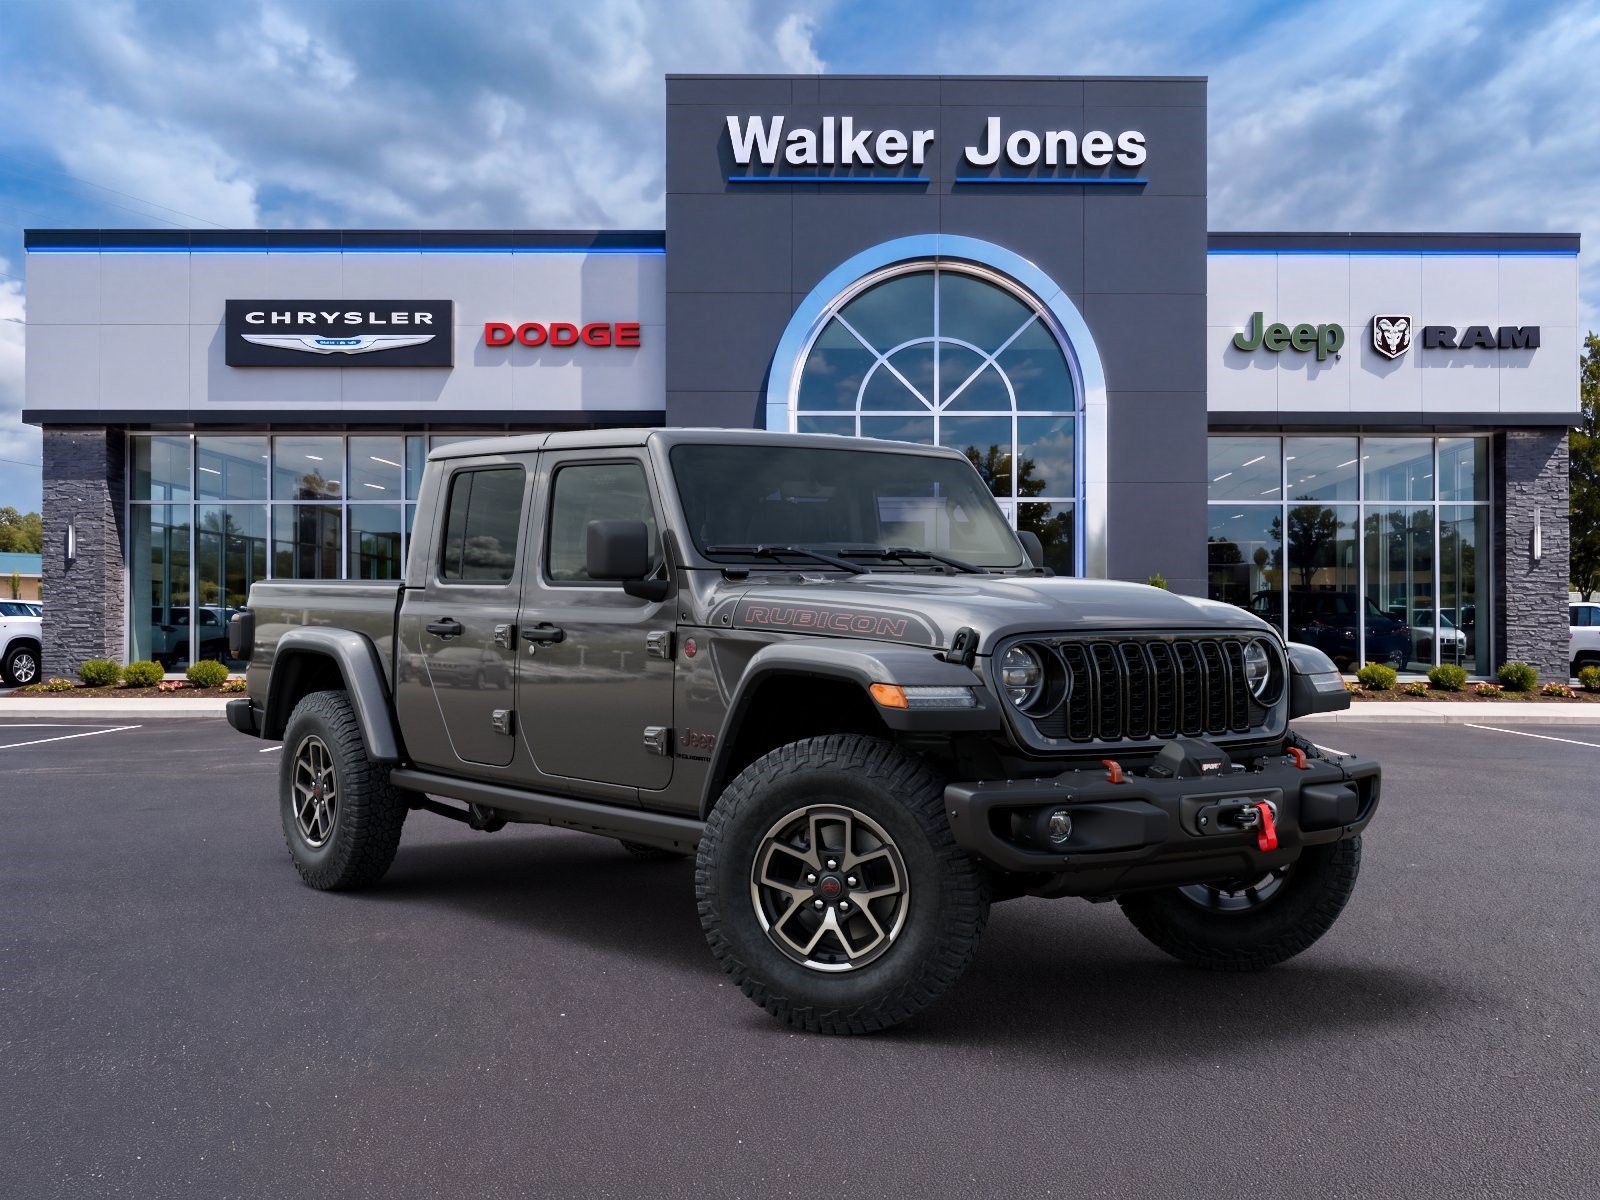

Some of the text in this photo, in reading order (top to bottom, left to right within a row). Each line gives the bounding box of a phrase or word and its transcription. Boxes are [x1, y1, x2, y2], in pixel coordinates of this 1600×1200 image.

[726, 115, 1148, 167] Walker Jones
[245, 311, 434, 325] CHRYSLER
[484, 322, 641, 348] DODGE
[1233, 311, 1345, 361] Jeep
[1423, 325, 1541, 349] RAM
[744, 605, 908, 637] RUBICON
[680, 727, 716, 754] Jeep
